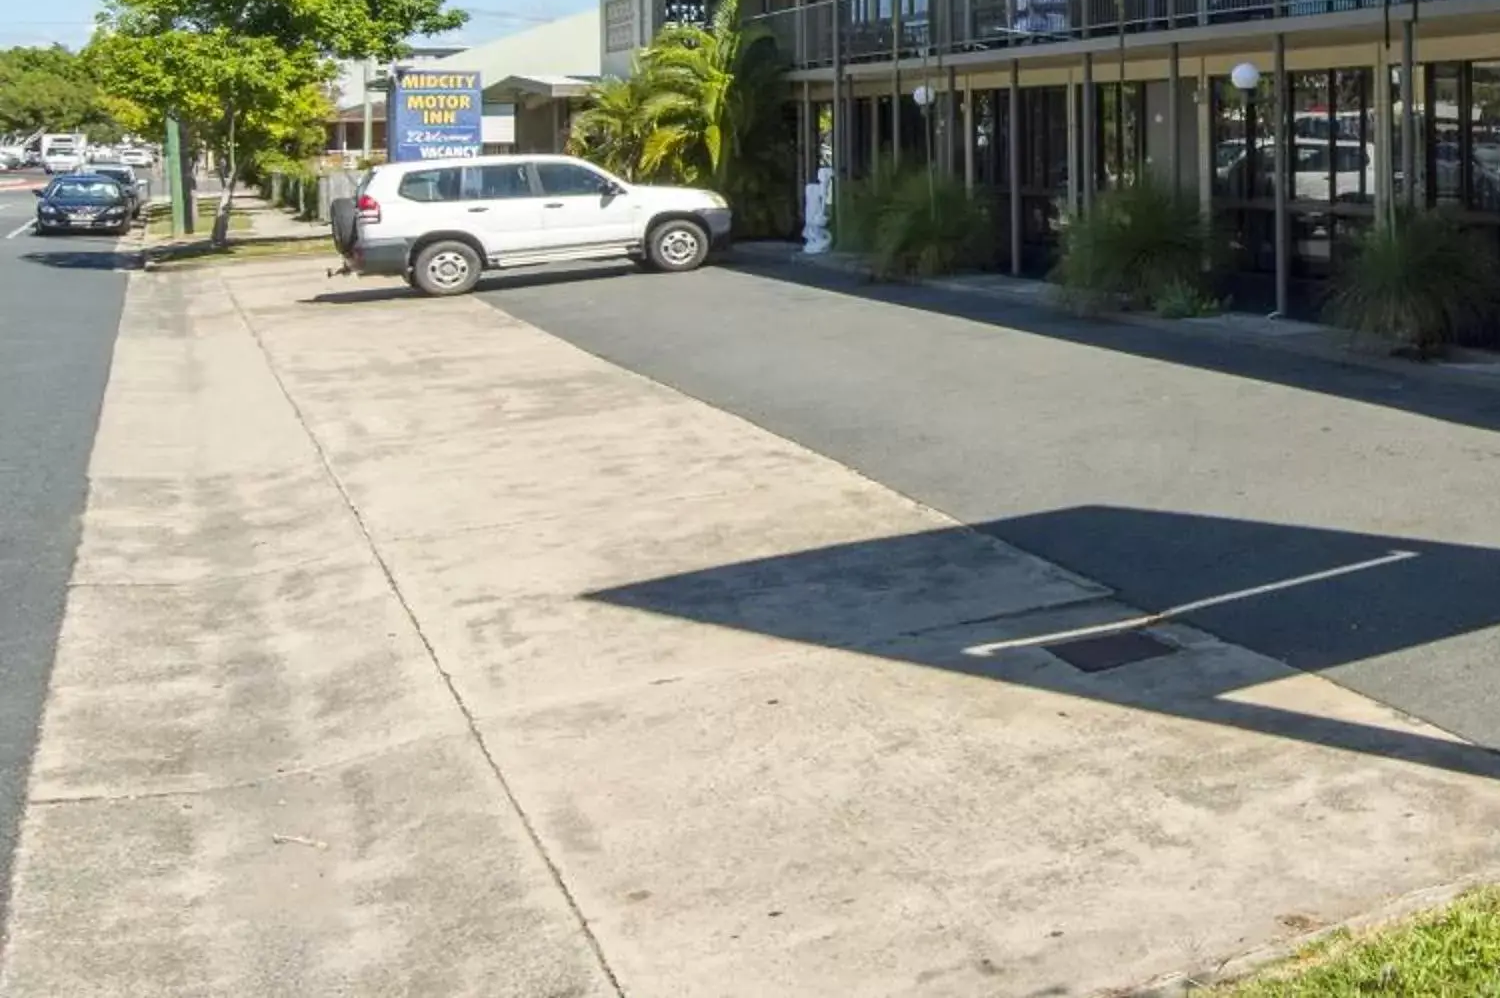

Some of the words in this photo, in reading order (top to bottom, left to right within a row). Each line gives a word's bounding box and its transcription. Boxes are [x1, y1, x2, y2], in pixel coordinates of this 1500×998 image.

[401, 74, 475, 89] MIDCITY
[407, 95, 471, 109] MOTOR
[424, 110, 457, 124] INN
[420, 145, 479, 159] VACANCY
